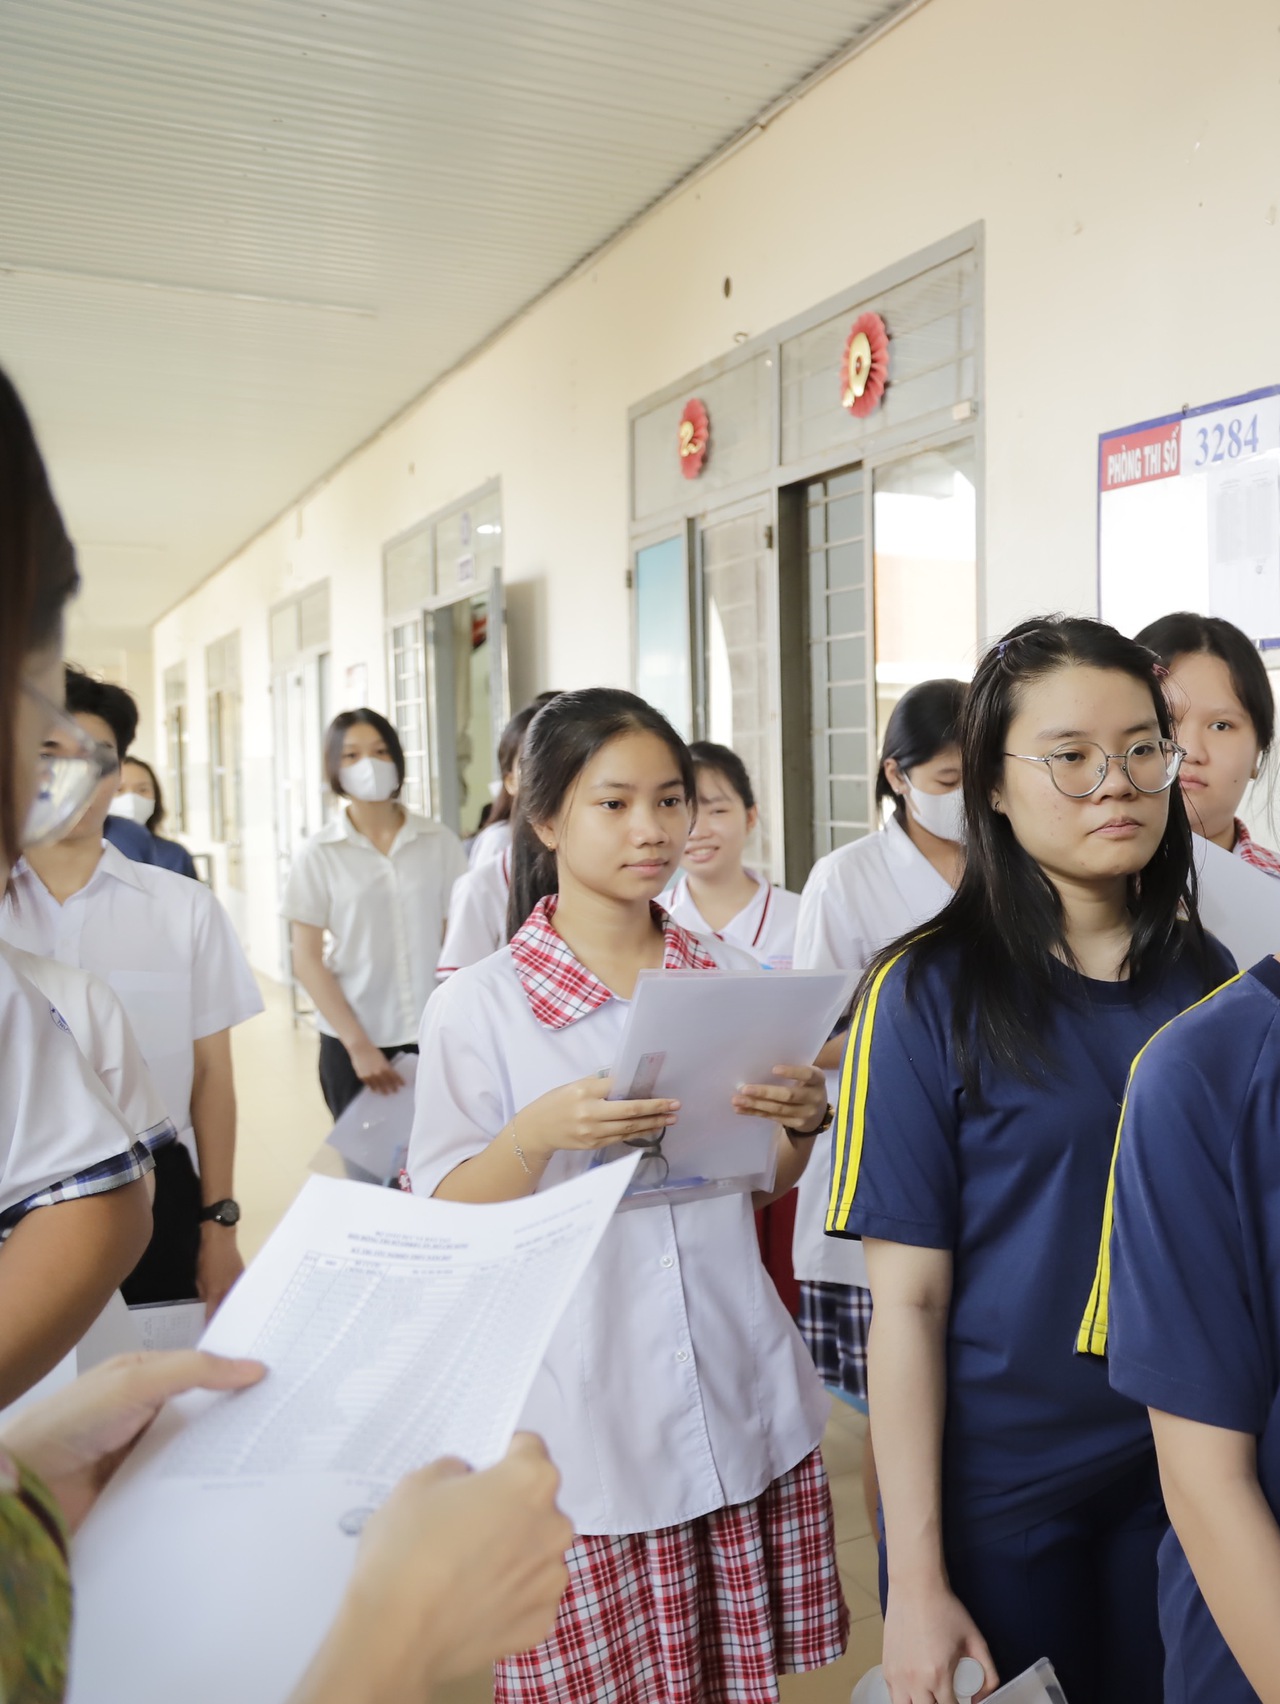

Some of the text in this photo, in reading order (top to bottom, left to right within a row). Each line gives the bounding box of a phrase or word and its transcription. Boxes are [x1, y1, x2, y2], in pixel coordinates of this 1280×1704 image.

[1107, 413, 1259, 485] PHÒNG THI SỐ 3284
